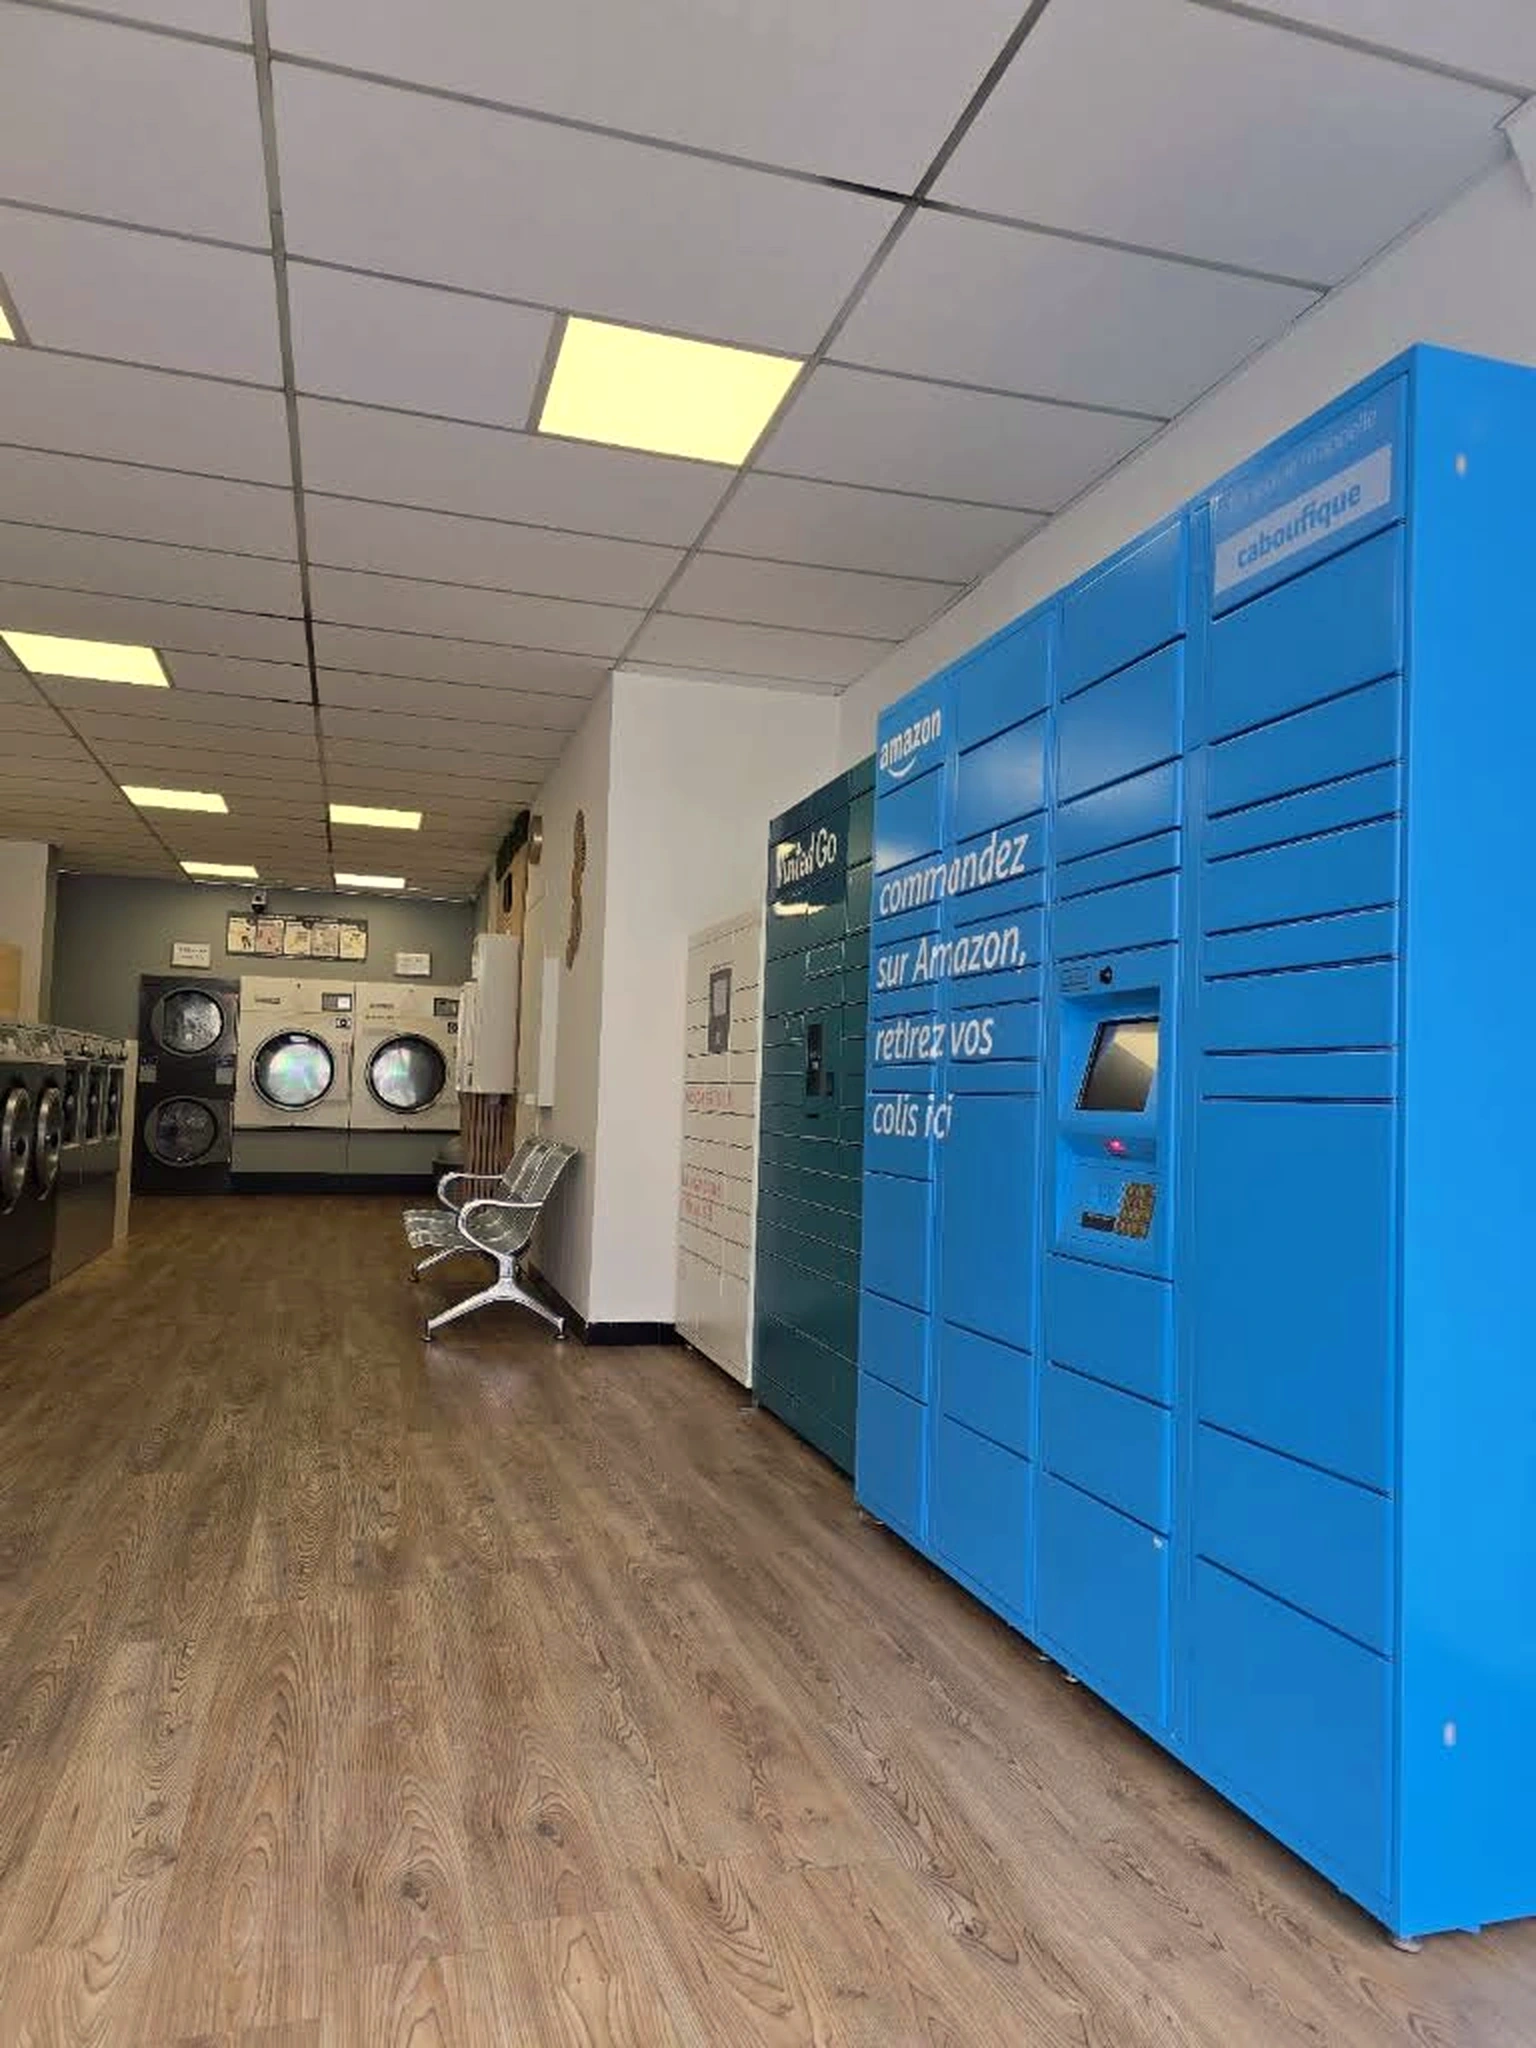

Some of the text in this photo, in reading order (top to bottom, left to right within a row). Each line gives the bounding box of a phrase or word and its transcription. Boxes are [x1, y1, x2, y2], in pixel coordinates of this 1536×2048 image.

[880, 708, 941, 770] amazon
[880, 830, 1029, 915] commandez
[876, 926, 1027, 989] sur Amazon,
[875, 1018, 993, 1060] retirez vos
[873, 1093, 953, 1139] colis ici
